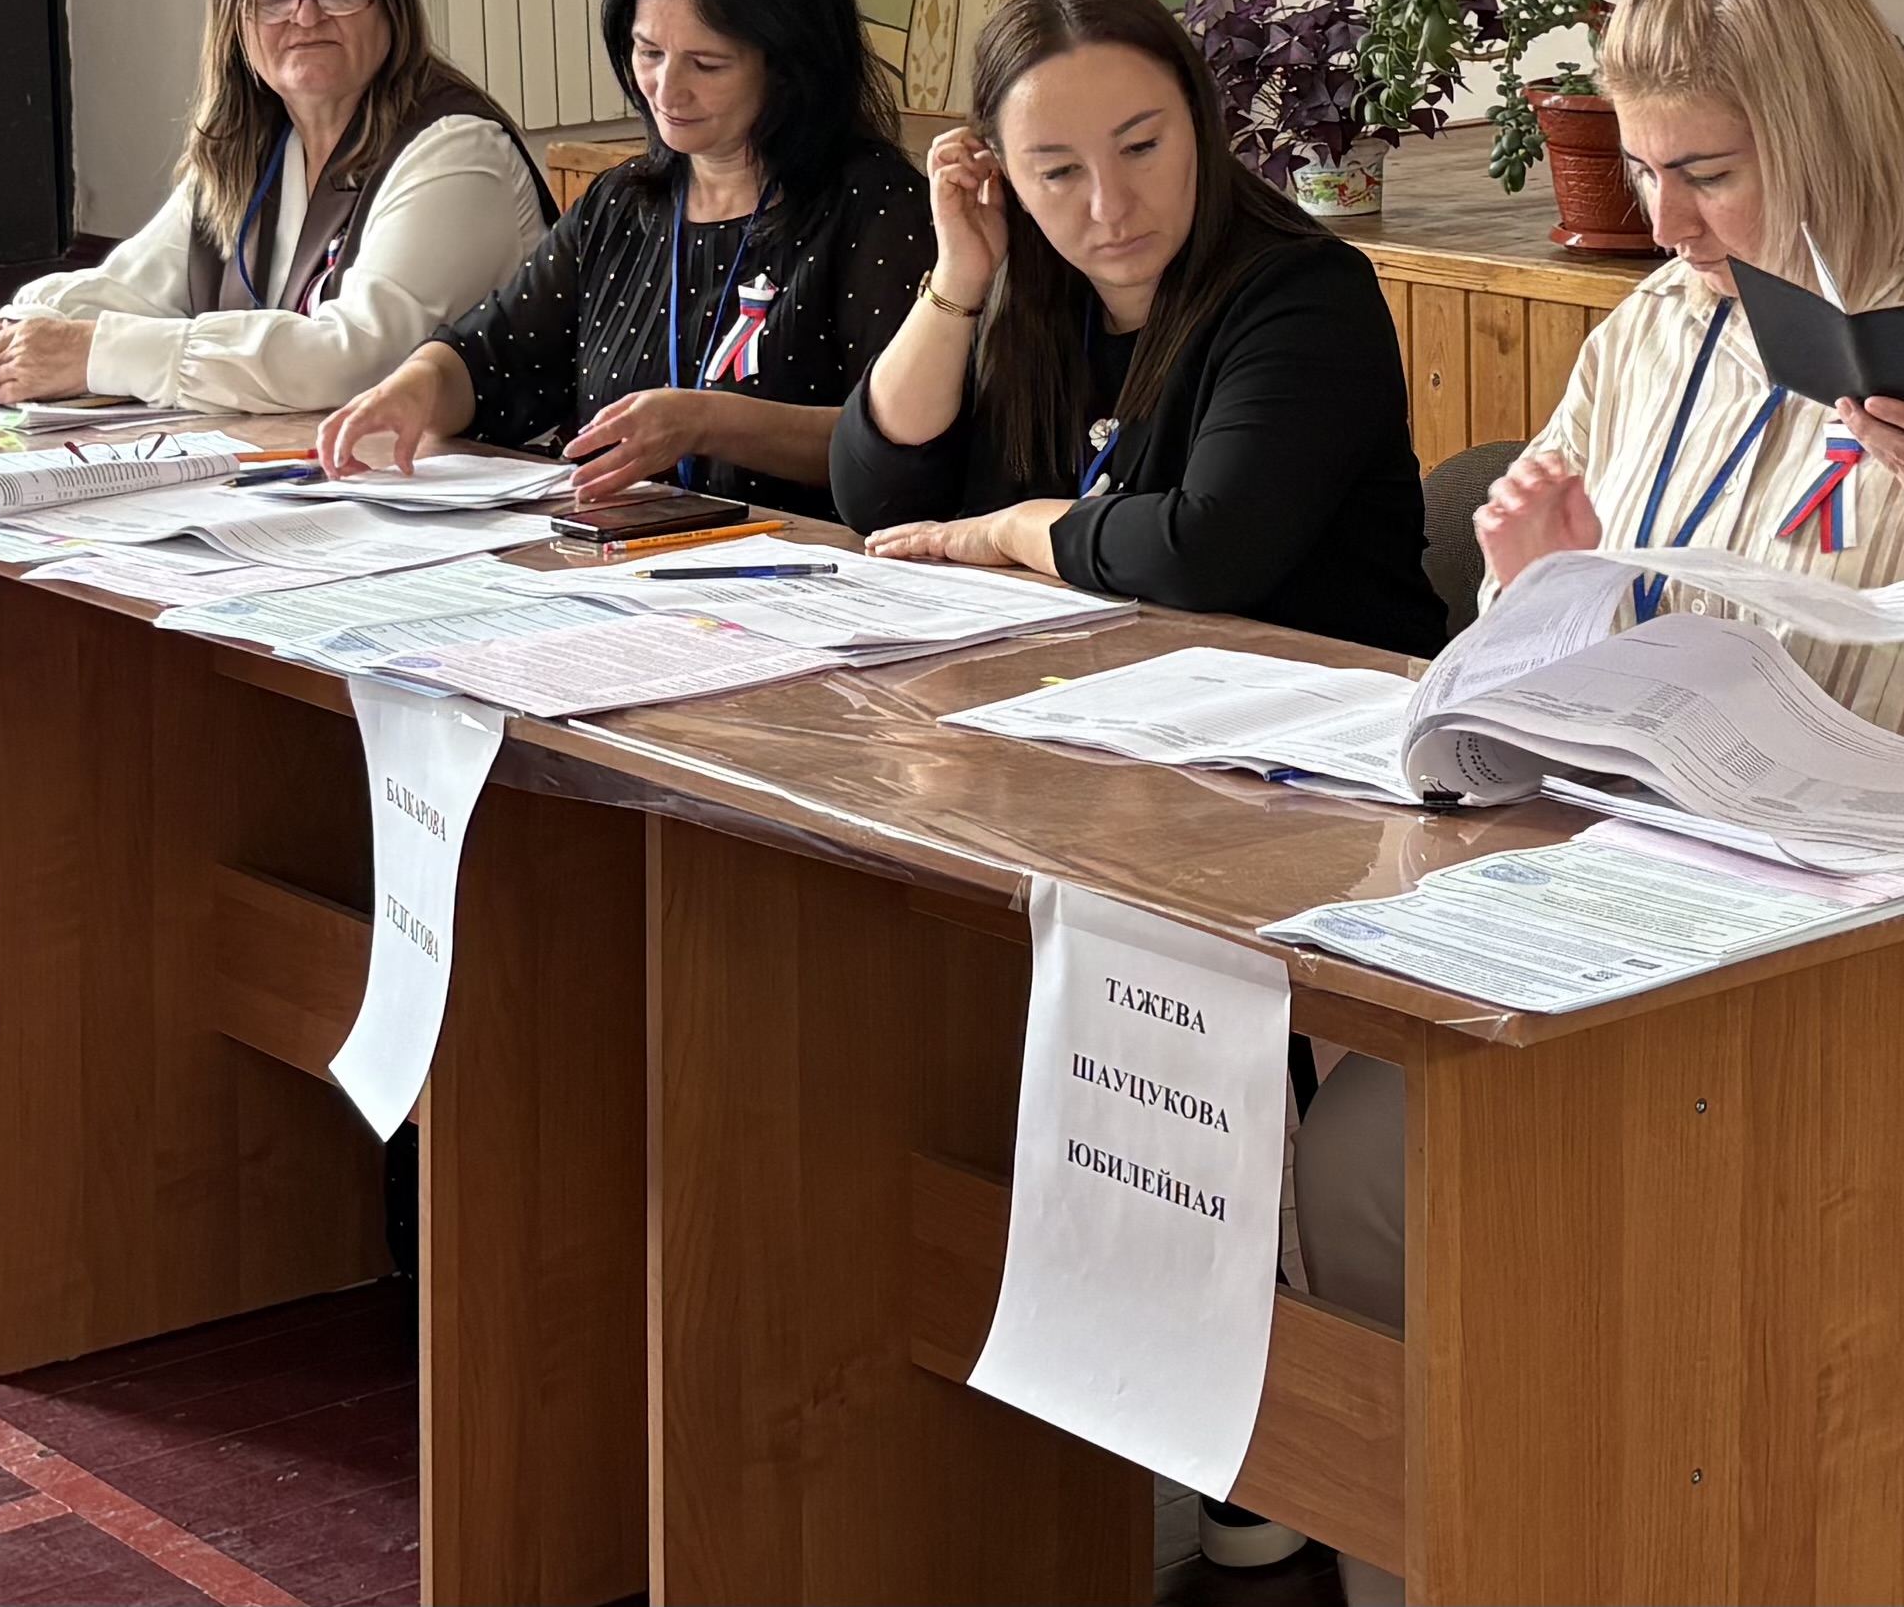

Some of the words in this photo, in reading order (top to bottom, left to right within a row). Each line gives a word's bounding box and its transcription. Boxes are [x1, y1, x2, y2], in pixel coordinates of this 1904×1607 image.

[386, 777, 446, 842] БАЛКАРОВА
[1105, 977, 1207, 1036] ТАЖЕВА
[1070, 1052, 1231, 1134] ШАУЦУКОВА
[1066, 1138, 1227, 1223] ЮБИЛЕЙНАЯ
